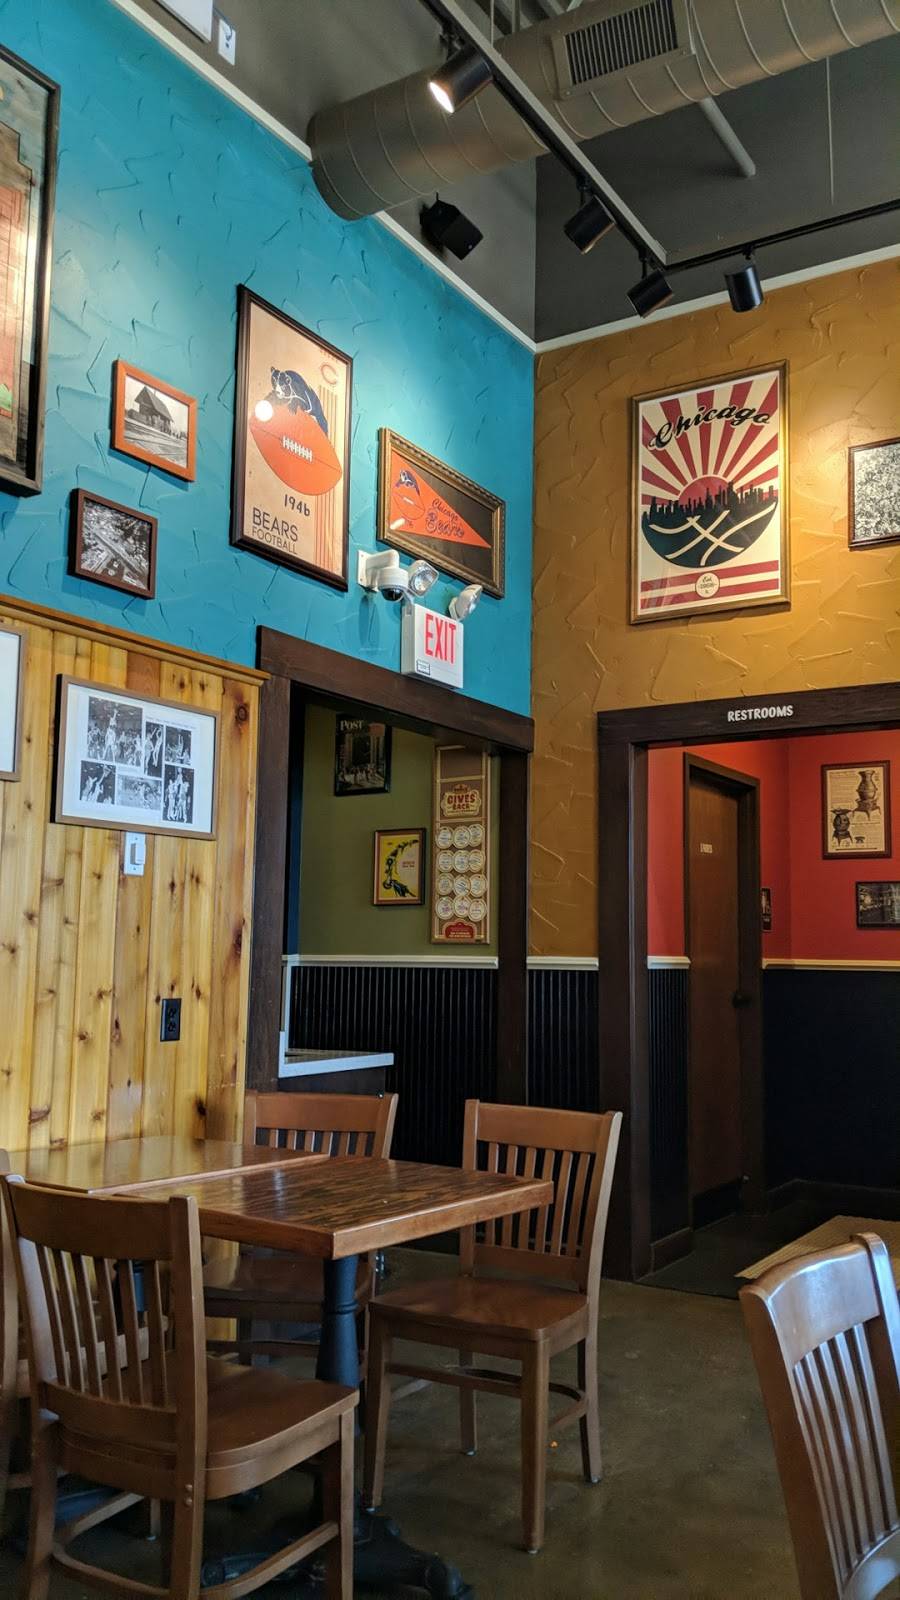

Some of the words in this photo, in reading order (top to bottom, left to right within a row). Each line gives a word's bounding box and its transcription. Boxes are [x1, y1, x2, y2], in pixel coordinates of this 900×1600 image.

[648, 406, 771, 450] Chicago
[283, 493, 311, 517] 1946
[252, 507, 299, 542] BEARS
[251, 526, 298, 555] FOOTBALL
[425, 613, 457, 664] EXIT
[339, 719, 364, 732] POST
[727, 704, 794, 722] RESTROOMS
[447, 794, 476, 804] GIVES
